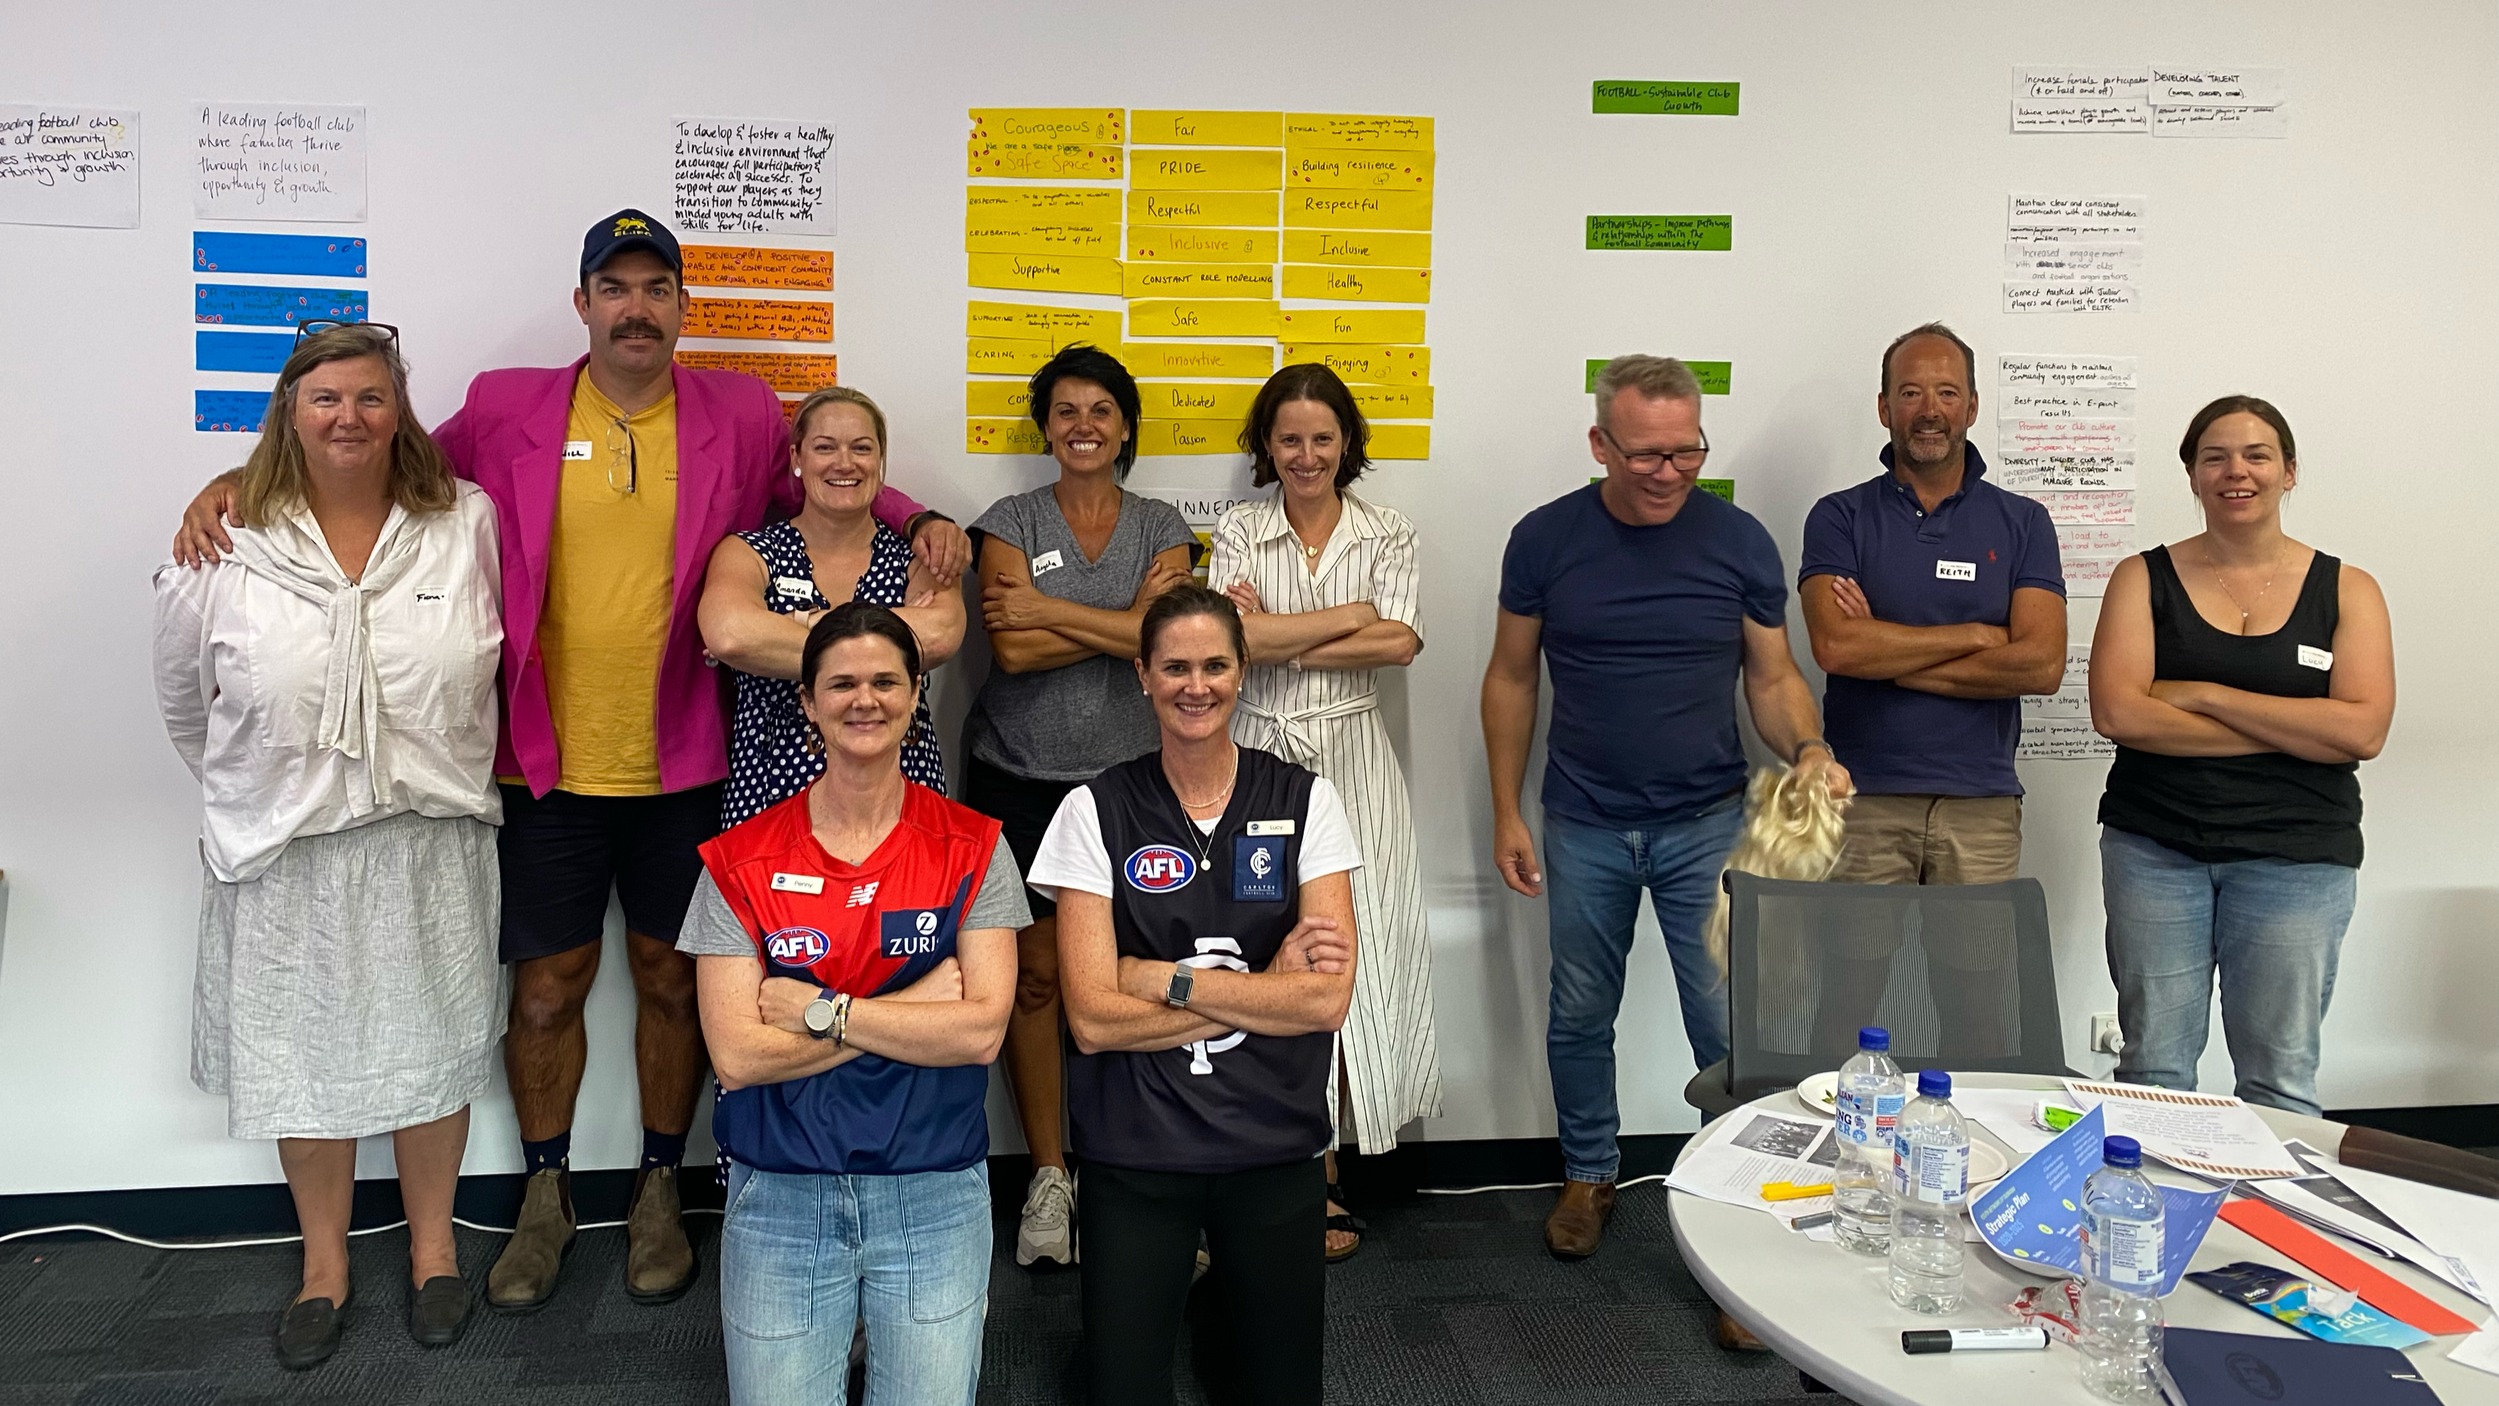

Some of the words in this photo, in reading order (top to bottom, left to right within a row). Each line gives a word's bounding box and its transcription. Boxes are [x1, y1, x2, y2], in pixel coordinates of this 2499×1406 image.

[218, 112, 267, 139] leading
[274, 112, 321, 134] football
[327, 117, 354, 132] club
[676, 121, 689, 135] To
[694, 124, 732, 145] develop
[749, 125, 779, 143] foster
[798, 126, 834, 149] healthy
[1003, 117, 1090, 139] Courageous
[1174, 116, 1196, 137] Fair
[41, 134, 107, 151] community
[198, 134, 231, 148] where
[302, 135, 342, 154] thrive
[687, 141, 734, 157] inclusive
[739, 146, 800, 160] environment
[804, 145, 826, 159] that
[24, 150, 77, 170] through
[198, 156, 248, 178] through
[733, 159, 749, 173] full
[1160, 161, 1206, 174] PRIDE
[1302, 160, 1339, 177] Building
[1347, 161, 1397, 170] resilience
[728, 171, 741, 182] all
[800, 172, 813, 183] To
[203, 176, 267, 205] opportunity
[675, 182, 712, 196] support
[717, 184, 737, 193] our
[743, 184, 777, 201] players
[782, 188, 792, 196] as
[799, 185, 822, 200] they
[675, 194, 732, 207] transition
[738, 196, 747, 207] to
[1147, 196, 1201, 218] Respectful
[1305, 197, 1378, 214] Respectful
[675, 208, 712, 219] minded
[714, 208, 743, 224] young
[747, 208, 784, 220] adults
[790, 209, 813, 221] with
[1170, 234, 1229, 250] Inclusive
[1319, 235, 1370, 256] Inclusive
[2023, 246, 2059, 257] Increased
[1012, 257, 1061, 278] Supportive
[1142, 275, 1193, 285] CONSTANT
[1327, 271, 1363, 294] Healthy
[1171, 306, 1198, 326] Safe
[1334, 316, 1351, 333] Fun
[975, 350, 1015, 359] CARING
[1324, 355, 1369, 372] Enjoying
[2003, 361, 2031, 373] Regular
[1172, 389, 1215, 408] Dedicated
[2034, 397, 2068, 408] practice
[1173, 422, 1206, 446] Passion
[1940, 568, 1971, 577] KEITH
[1135, 858, 1185, 879] AFL
[769, 936, 824, 957] AFL
[1985, 1206, 2017, 1236] Strategic
[2013, 1192, 2030, 1210] Plan
[2316, 1312, 2377, 1331] Tack
